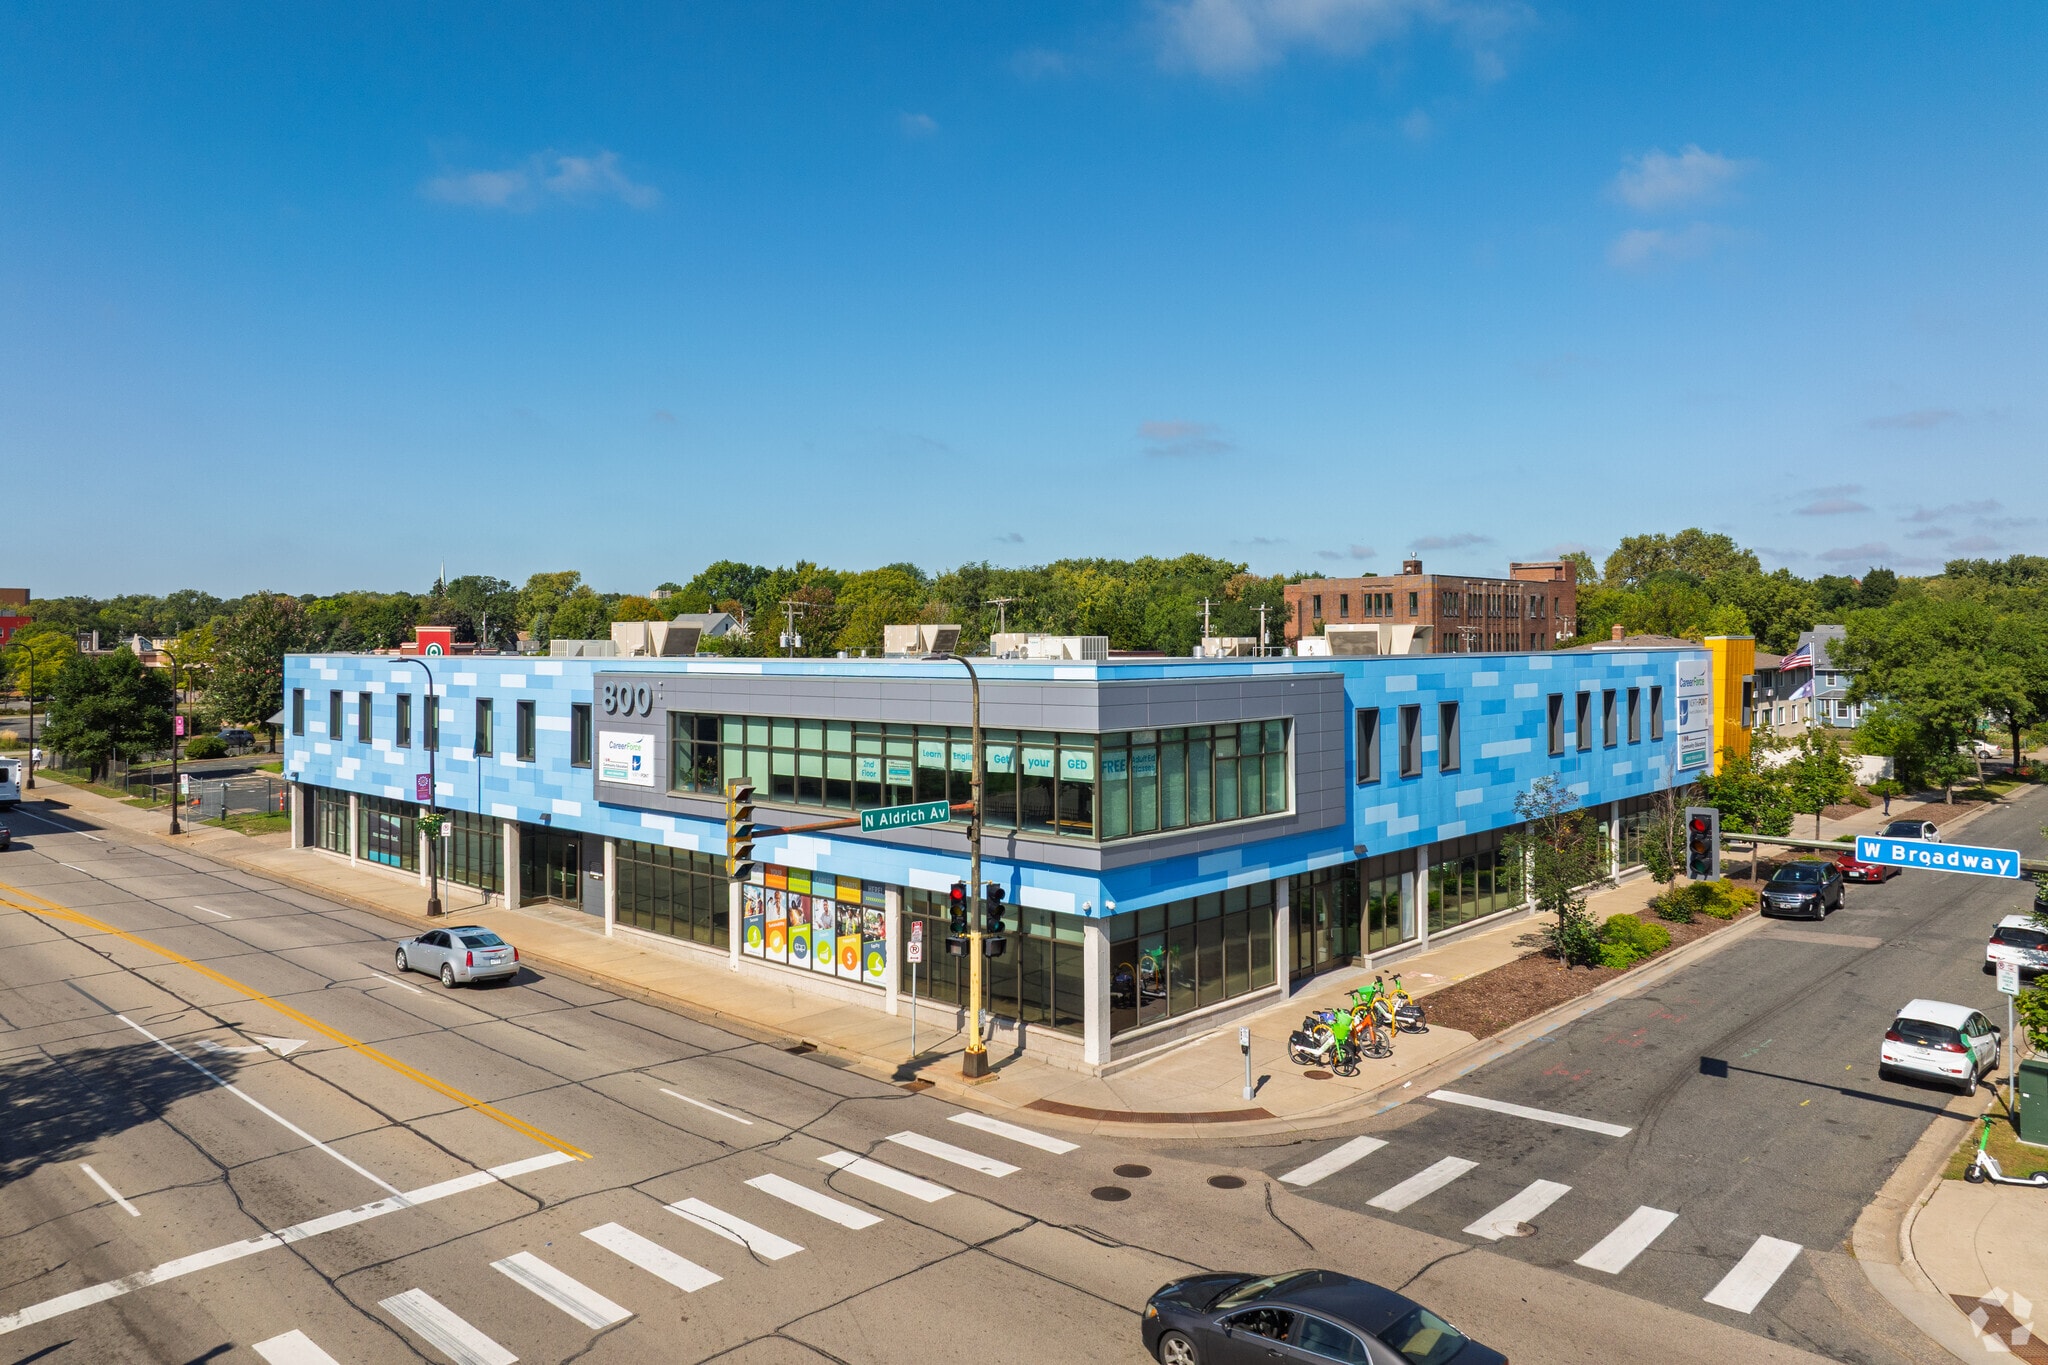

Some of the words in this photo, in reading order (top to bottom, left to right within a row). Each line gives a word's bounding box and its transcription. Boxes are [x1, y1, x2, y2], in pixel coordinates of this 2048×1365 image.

[1680, 677, 1705, 688] CareerForce
[602, 681, 652, 717] 800
[609, 740, 642, 751] CareerForce
[922, 749, 942, 759] Learn
[863, 760, 875, 769] 2nd
[993, 754, 1010, 764] Get
[1028, 758, 1051, 769] your
[1067, 759, 1088, 770] GED
[1101, 759, 1126, 774] FREE
[861, 769, 877, 778] Floor
[865, 814, 874, 828] N
[879, 809, 925, 826] Aldrich
[929, 806, 946, 820] Av
[1864, 841, 1881, 858] W
[1891, 845, 2011, 875] Broadway
